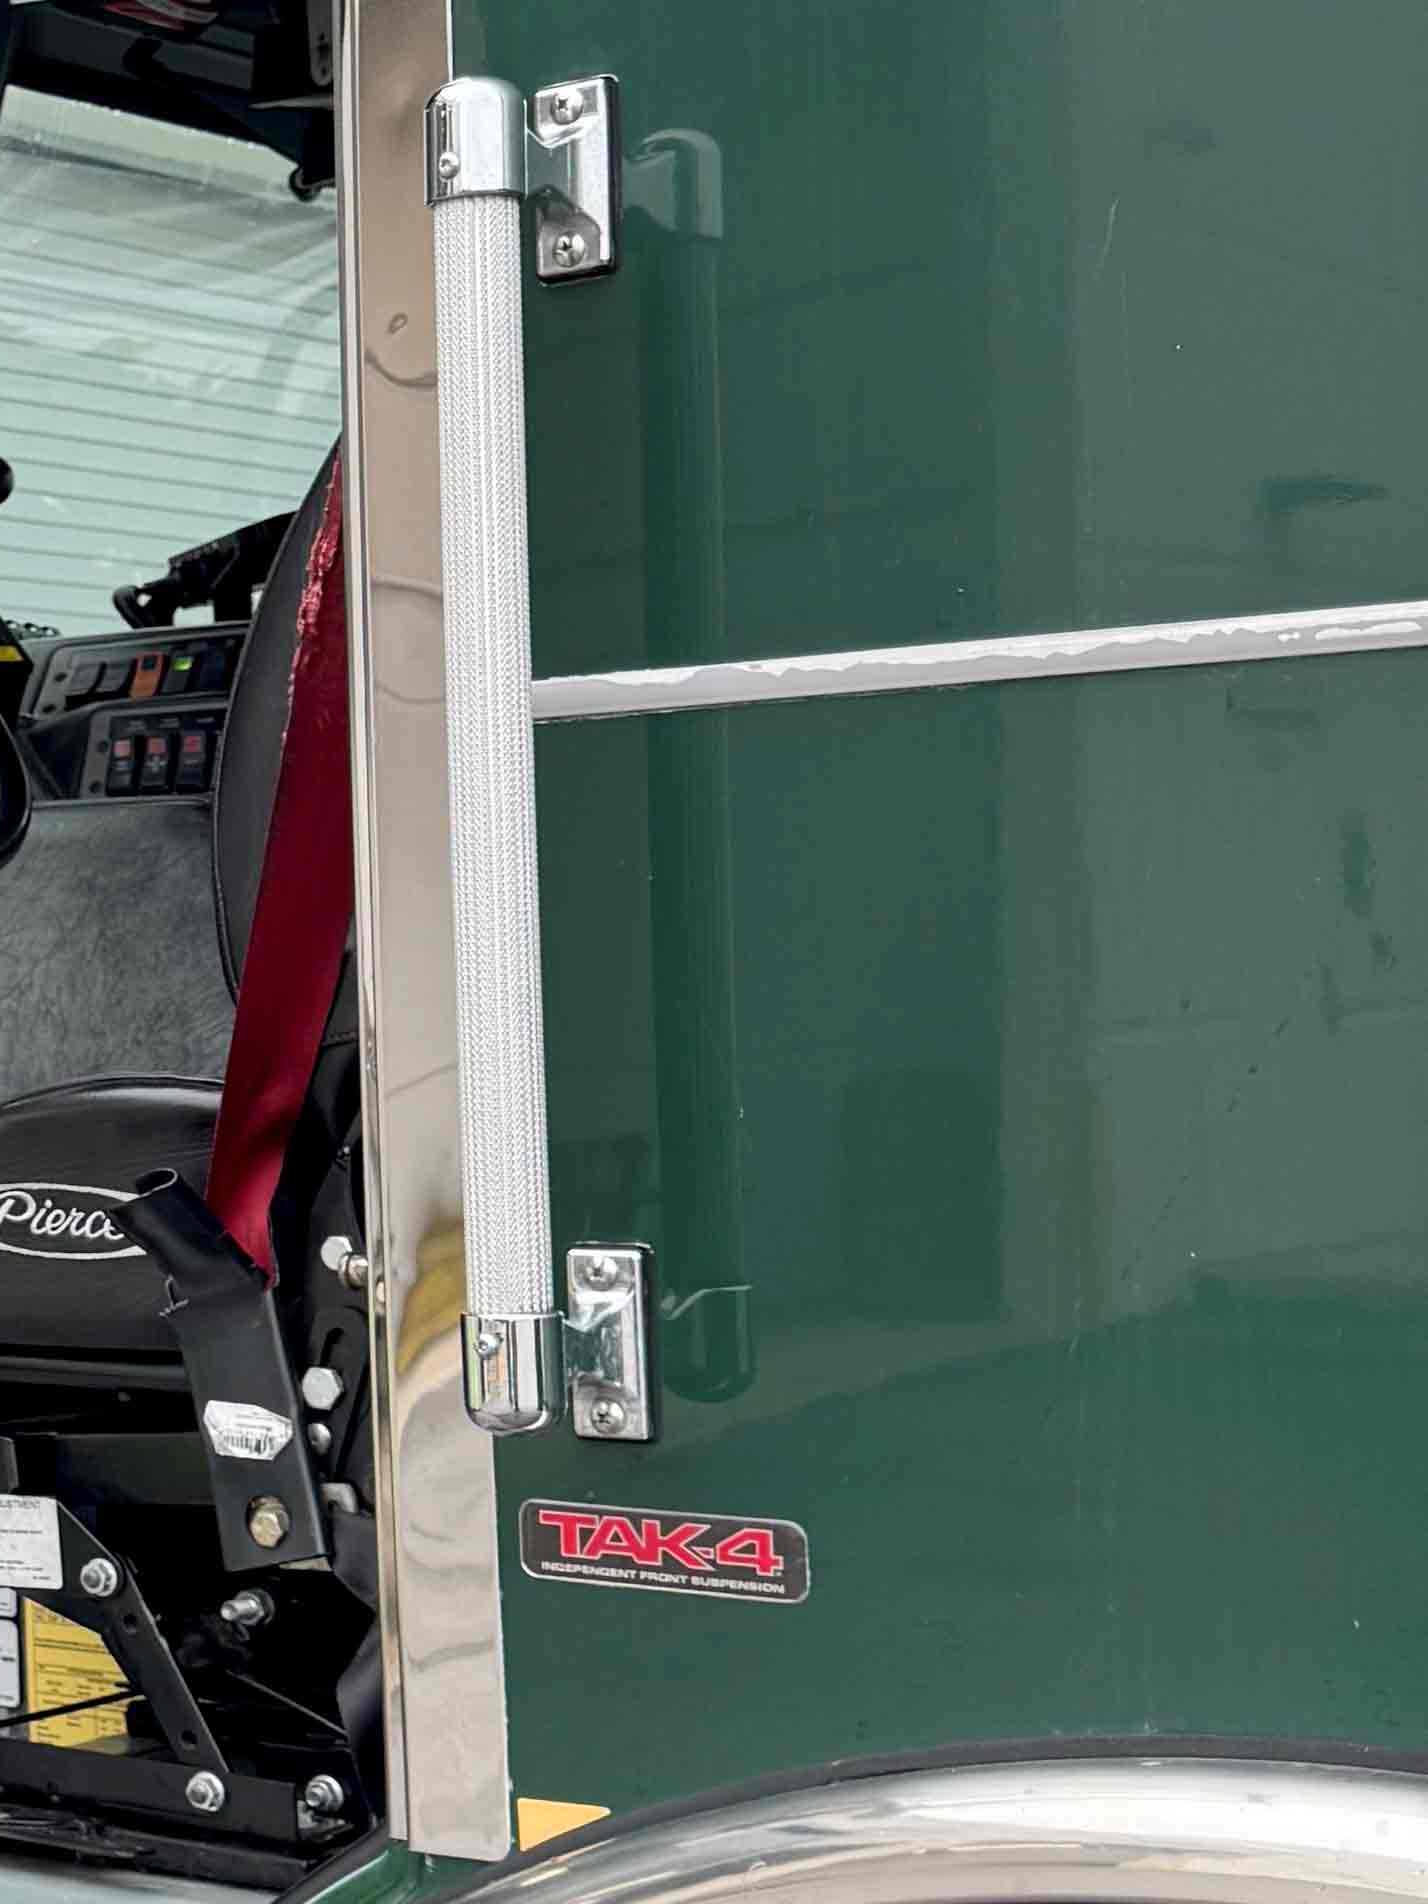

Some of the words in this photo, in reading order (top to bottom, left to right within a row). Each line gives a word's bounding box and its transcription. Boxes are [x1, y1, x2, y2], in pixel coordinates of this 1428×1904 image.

[538, 1509, 785, 1577] TAK-4
[541, 1560, 636, 1580] INDEPENDENT
[639, 1571, 688, 1586] FRONT
[691, 1575, 785, 1594] SUSPENSION
